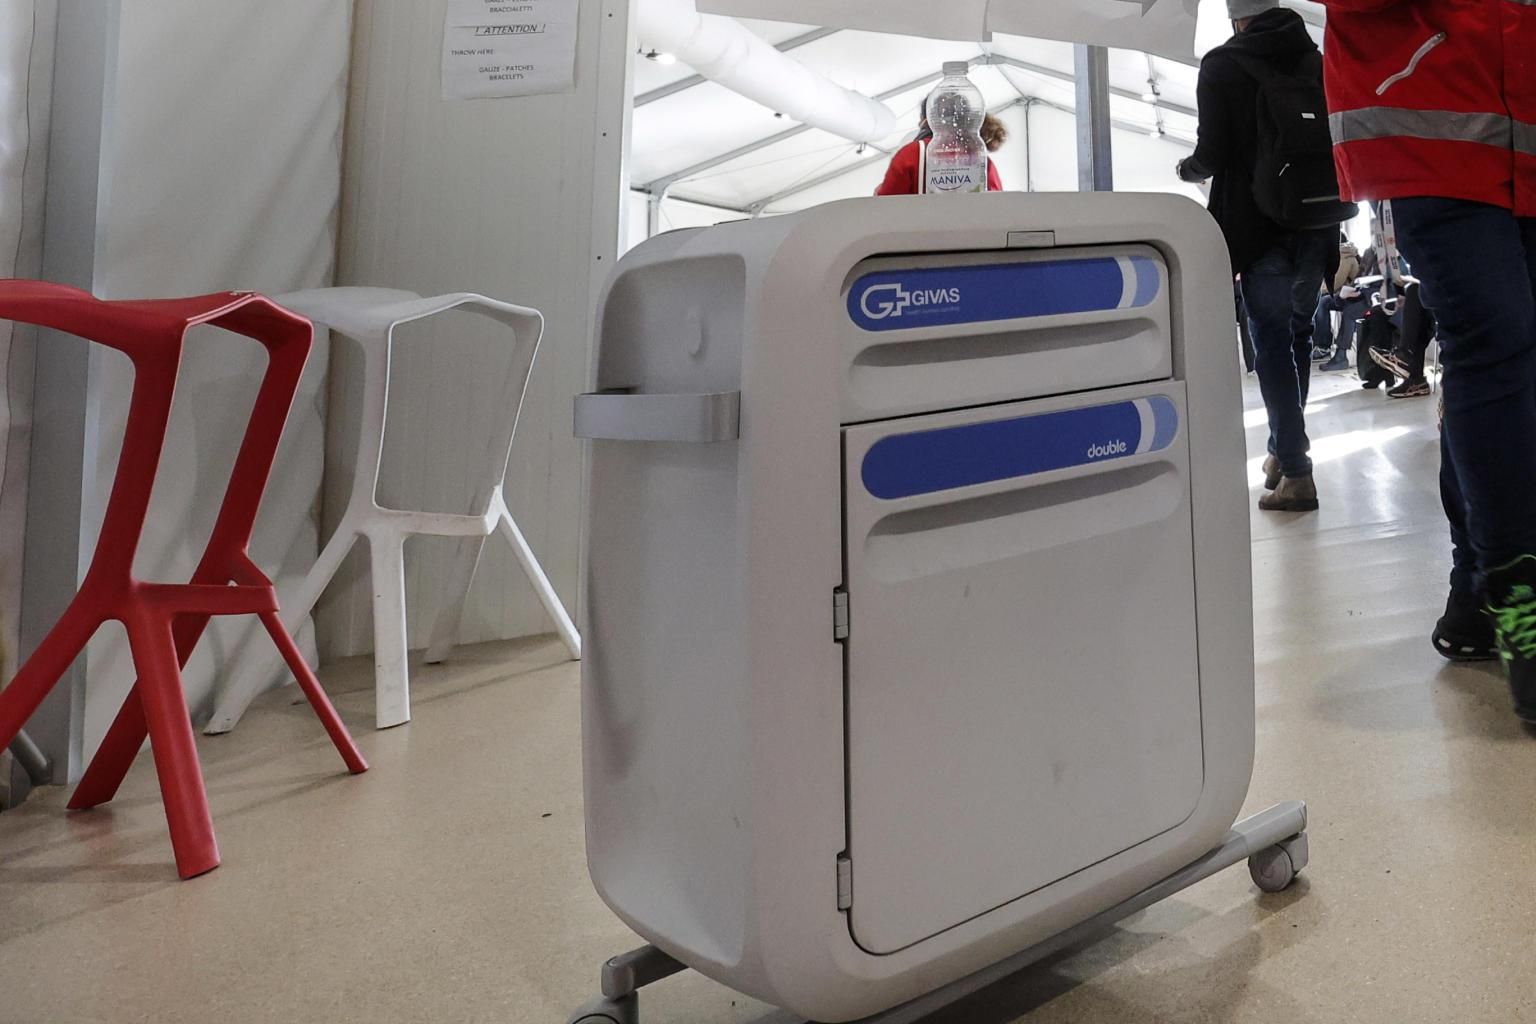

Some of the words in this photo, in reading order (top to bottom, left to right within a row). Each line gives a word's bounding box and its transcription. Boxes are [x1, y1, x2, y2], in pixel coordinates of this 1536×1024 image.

[483, 24, 538, 35] ATTENTION
[911, 287, 961, 306] GIVAS
[1087, 439, 1128, 458] double
